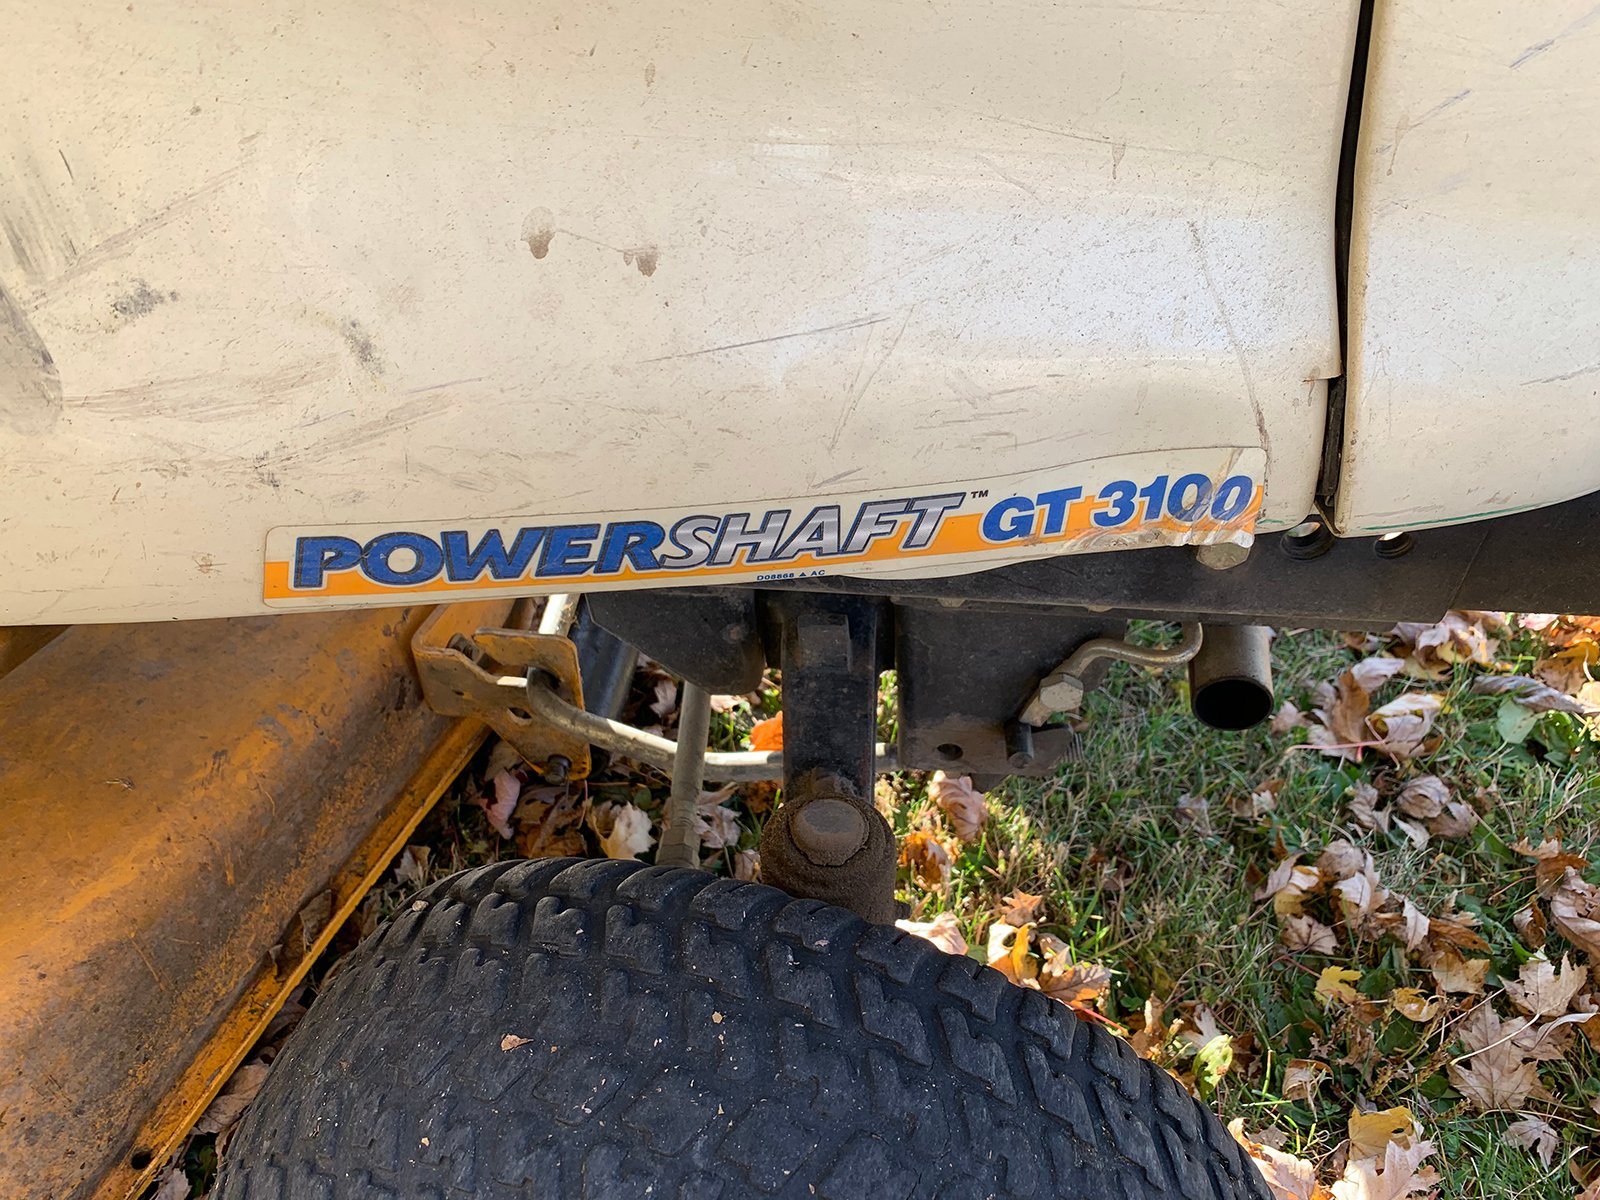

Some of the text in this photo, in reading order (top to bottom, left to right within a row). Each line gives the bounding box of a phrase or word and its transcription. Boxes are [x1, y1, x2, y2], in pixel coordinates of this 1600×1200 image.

[294, 494, 966, 590] POWERSHAFT
[982, 486, 1082, 542] GT
[1093, 473, 1253, 528] 3100
[811, 569, 826, 577] AC
